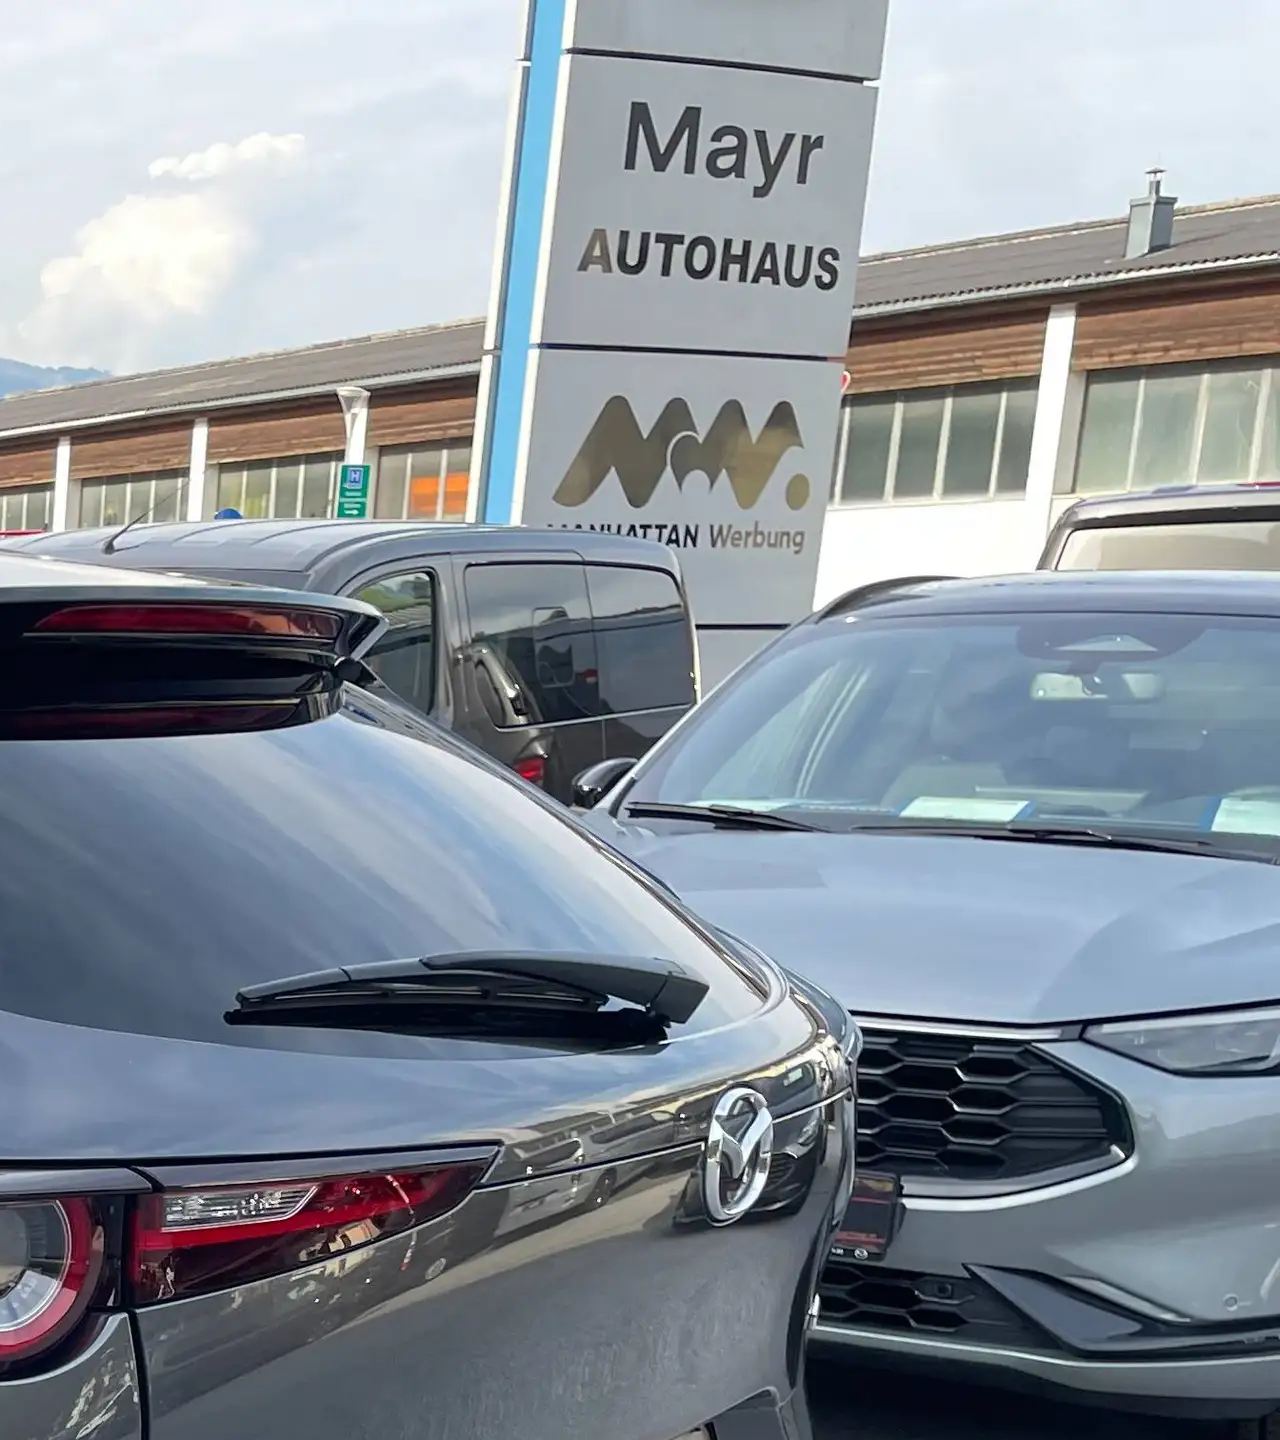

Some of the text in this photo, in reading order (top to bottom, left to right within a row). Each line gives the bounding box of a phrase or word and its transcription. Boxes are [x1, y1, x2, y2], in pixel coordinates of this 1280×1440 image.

[624, 100, 824, 198] Mayr
[577, 227, 840, 291] AUTOHAUS
[709, 519, 806, 555] Werbung
